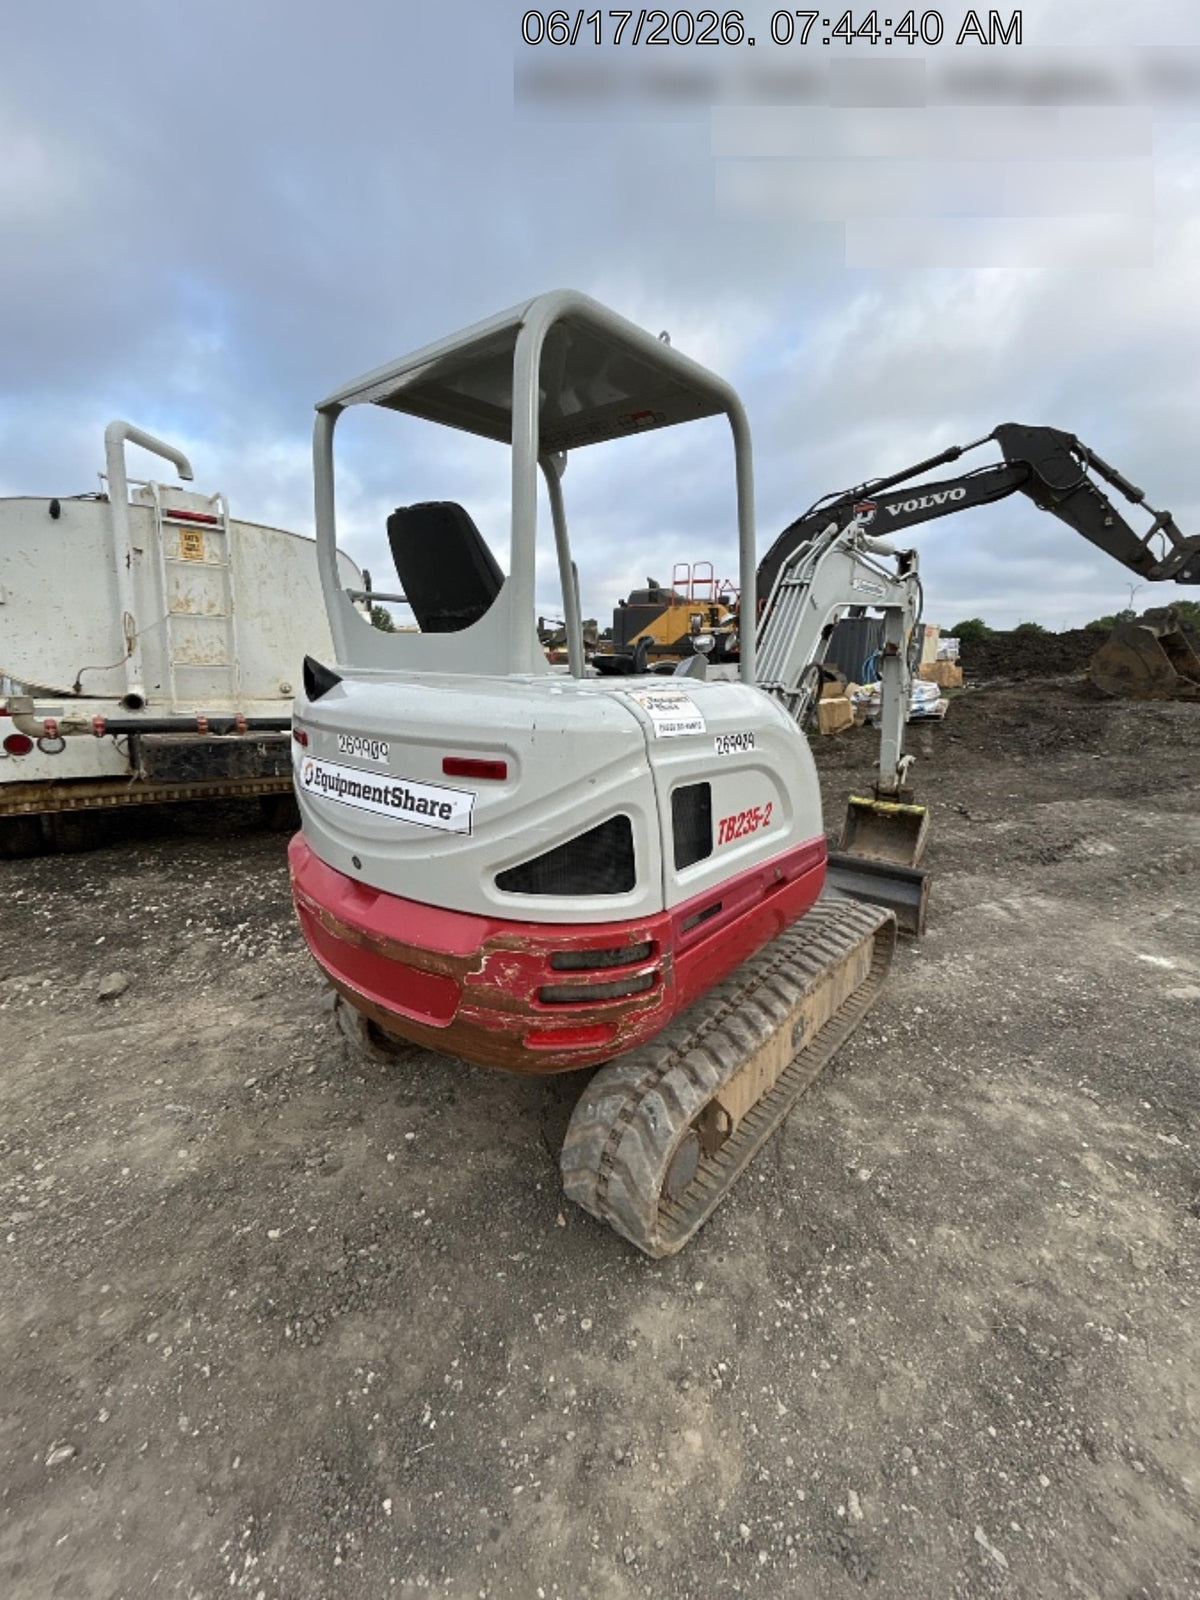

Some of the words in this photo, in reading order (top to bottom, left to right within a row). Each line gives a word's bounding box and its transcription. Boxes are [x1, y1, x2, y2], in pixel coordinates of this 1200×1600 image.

[886, 488, 966, 516] VOLVO
[314, 767, 453, 821] EquipmentShare
[718, 802, 773, 846] TB235-2
